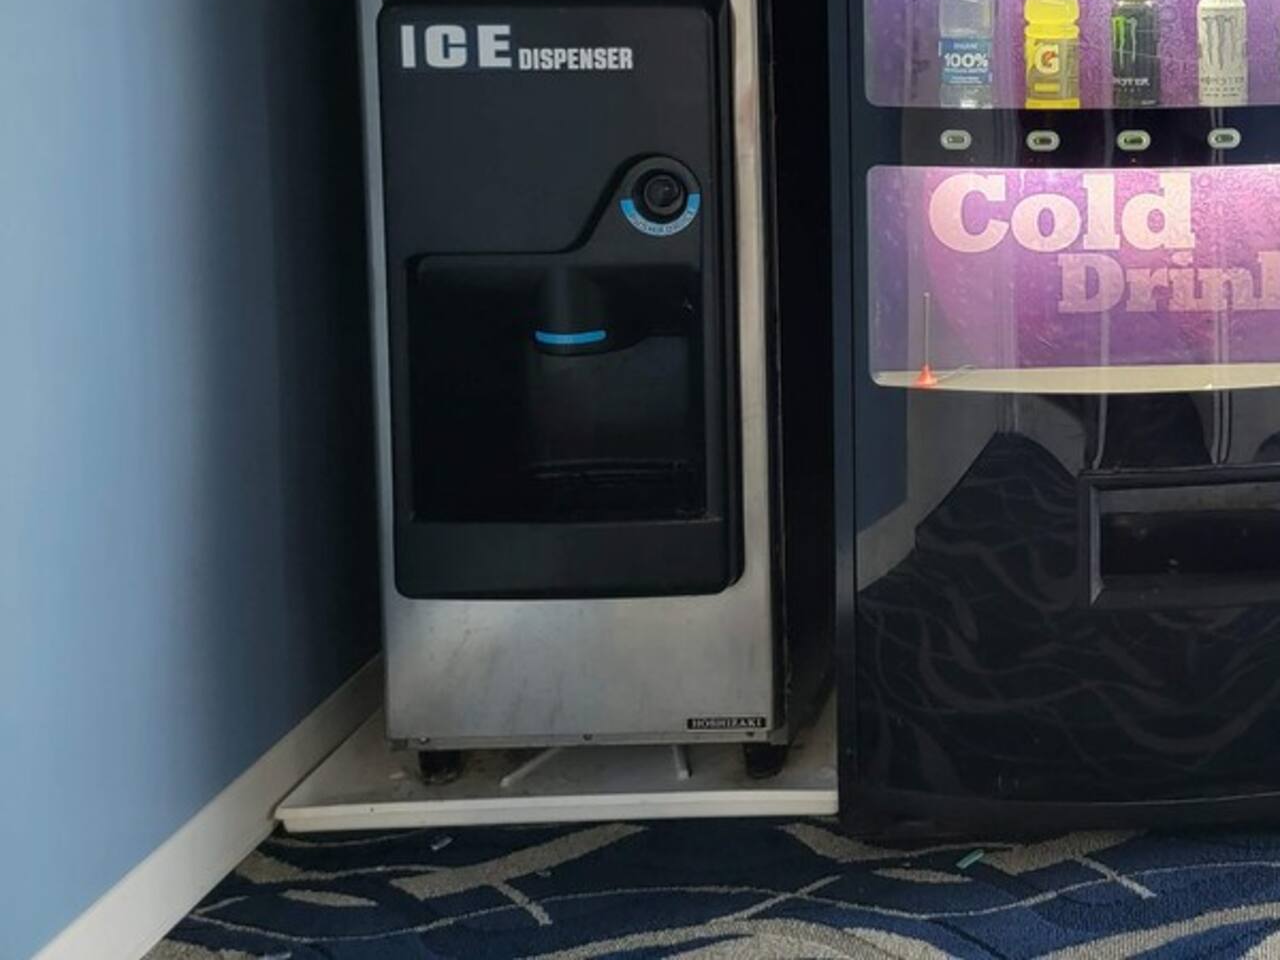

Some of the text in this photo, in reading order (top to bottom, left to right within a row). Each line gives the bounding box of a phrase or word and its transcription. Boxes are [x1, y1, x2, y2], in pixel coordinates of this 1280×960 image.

[401, 24, 634, 70] ICE DISPENSER
[944, 52, 989, 69] 100%
[929, 172, 1195, 252] Cold
